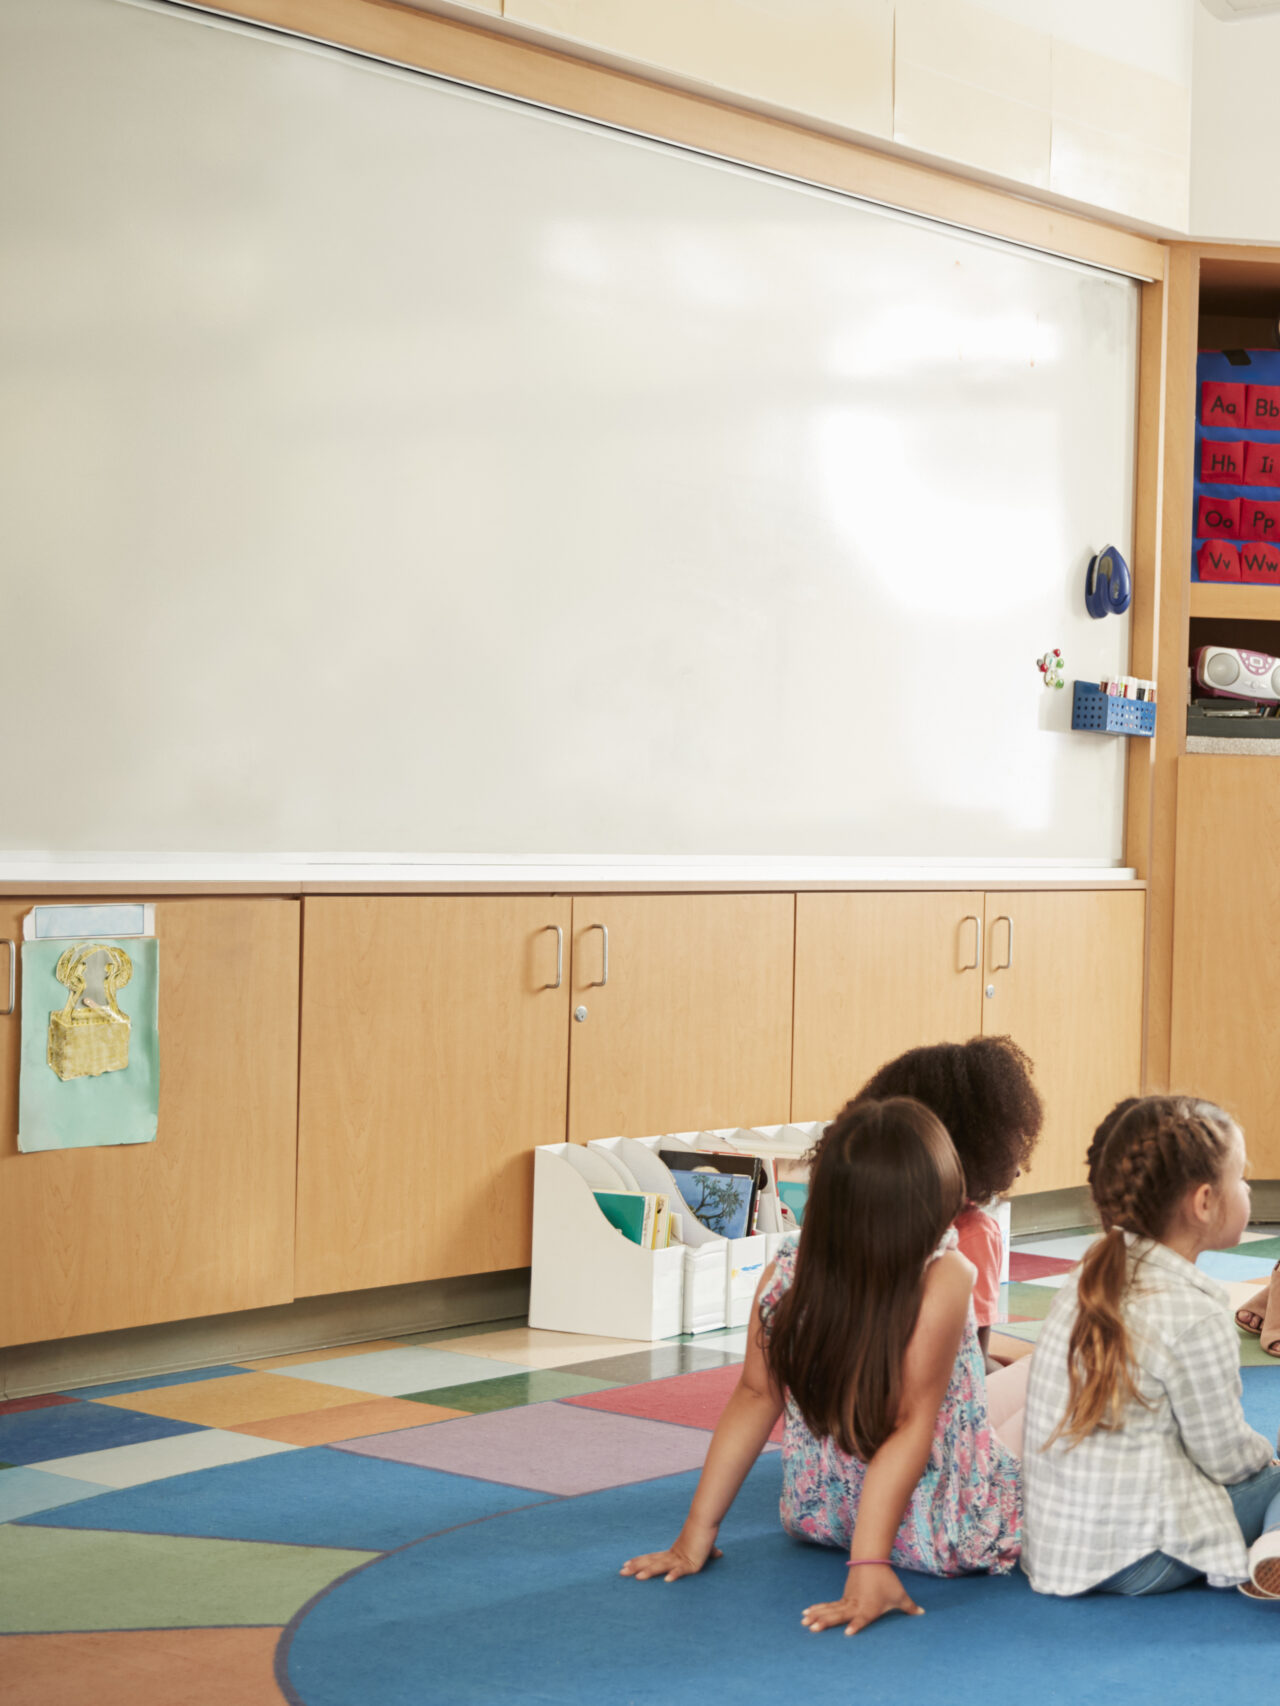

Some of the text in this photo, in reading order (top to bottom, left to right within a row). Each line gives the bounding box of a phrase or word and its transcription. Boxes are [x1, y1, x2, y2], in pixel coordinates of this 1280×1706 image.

[1210, 396, 1237, 415] Aa
[1255, 398, 1280, 418] Bb
[1210, 454, 1237, 473] Hh
[1259, 456, 1274, 474] Ii
[1204, 510, 1234, 529] Oo
[1252, 511, 1276, 535] Pp
[1208, 552, 1231, 570] Vv
